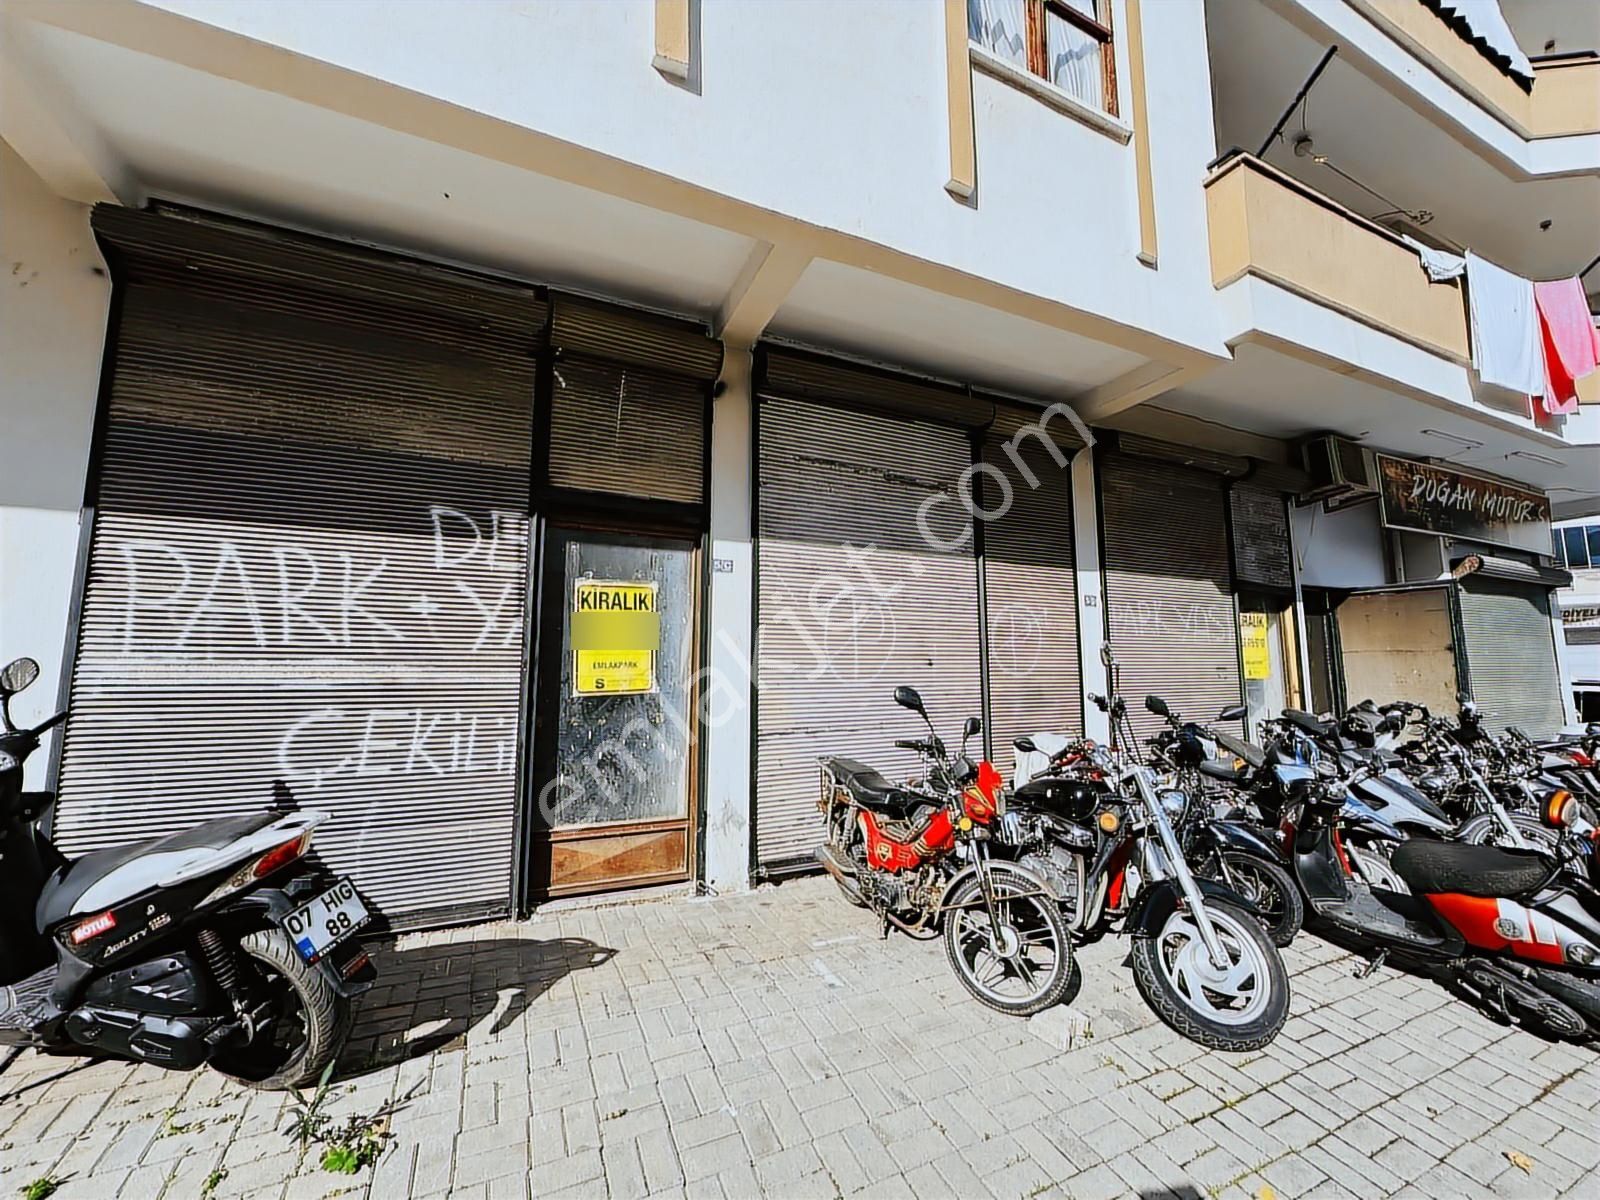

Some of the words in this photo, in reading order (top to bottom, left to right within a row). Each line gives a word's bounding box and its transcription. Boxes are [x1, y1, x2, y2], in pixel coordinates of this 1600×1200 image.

[119, 540, 405, 654] PARK
[580, 588, 650, 611] KİRALIK
[592, 660, 639, 670] EMLAKPARK
[287, 906, 313, 935] 07
[320, 883, 353, 913] HIG
[325, 911, 352, 936] 88
